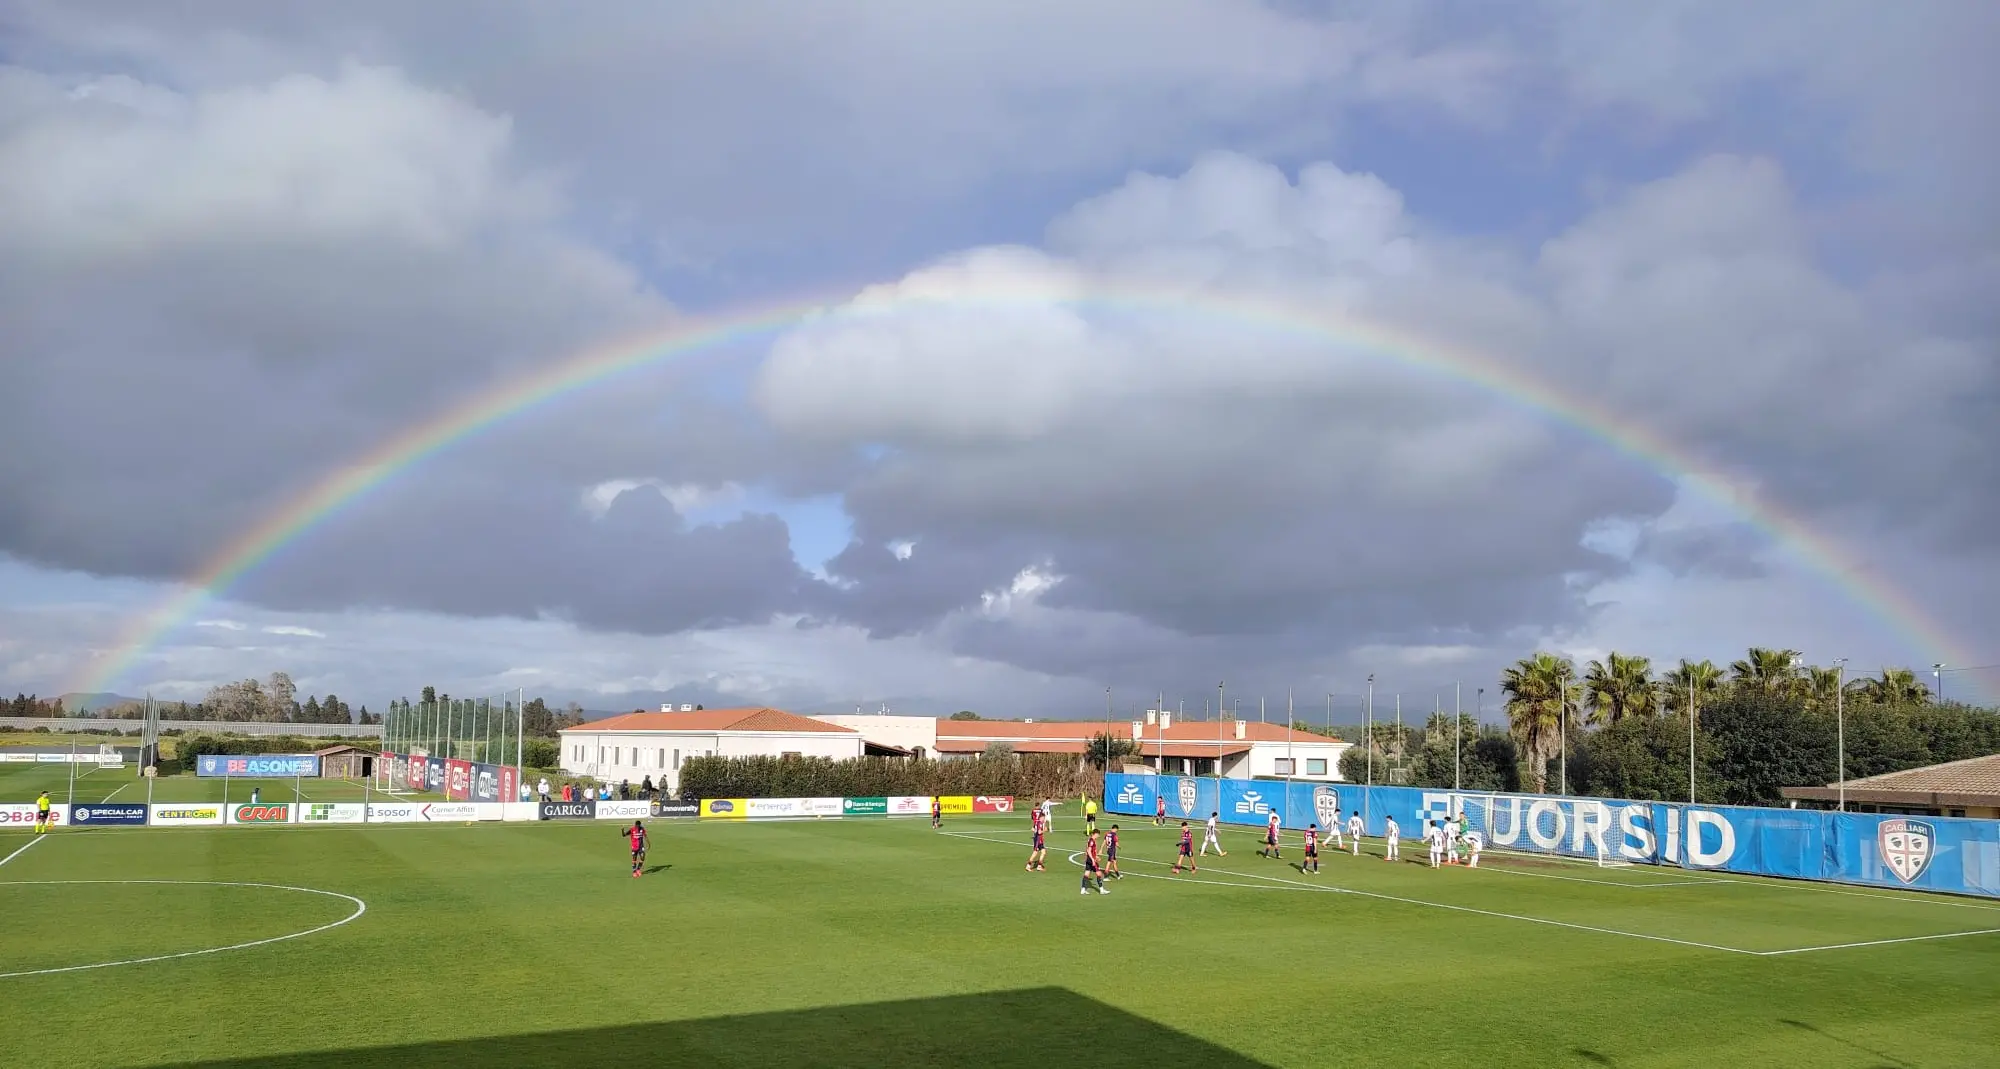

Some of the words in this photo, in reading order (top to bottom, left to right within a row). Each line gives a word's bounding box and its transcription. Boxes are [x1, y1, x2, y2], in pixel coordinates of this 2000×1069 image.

[238, 806, 287, 821] CRAI
[377, 807, 411, 817] sosor
[544, 805, 590, 815] GARIGA
[1884, 823, 1929, 836] CAGLIARI
